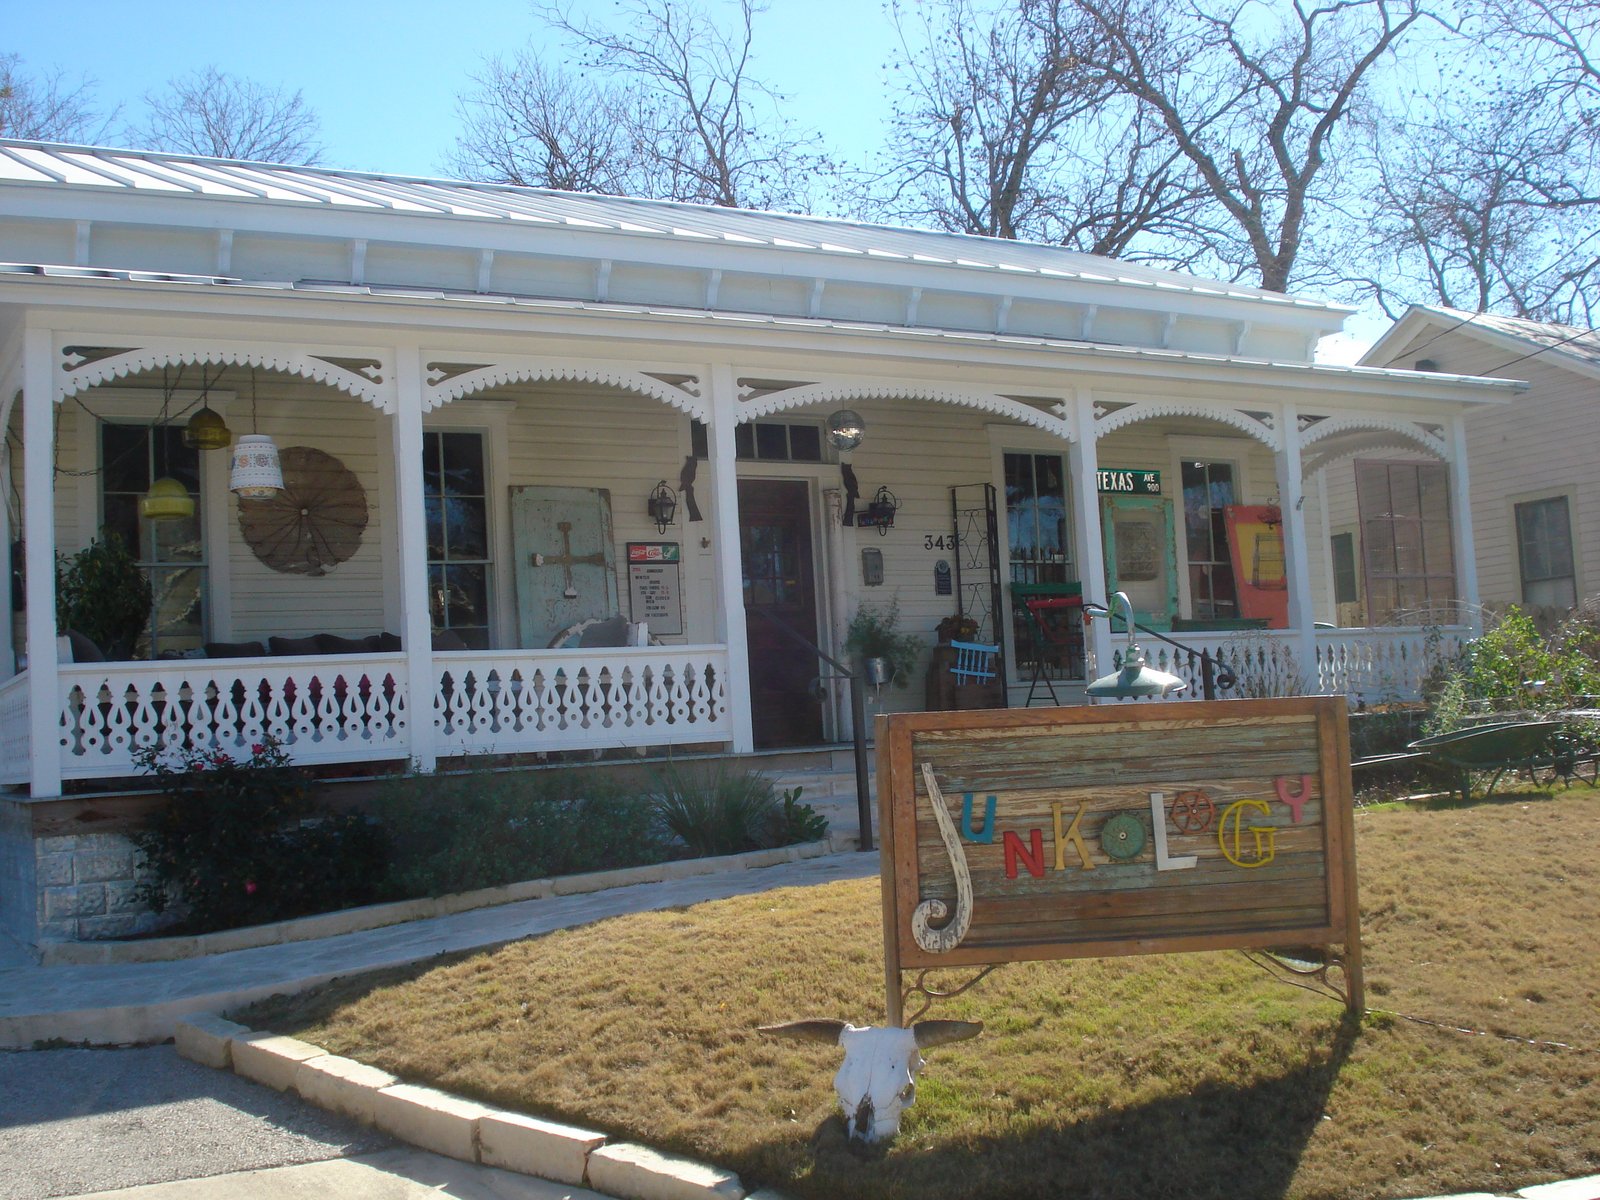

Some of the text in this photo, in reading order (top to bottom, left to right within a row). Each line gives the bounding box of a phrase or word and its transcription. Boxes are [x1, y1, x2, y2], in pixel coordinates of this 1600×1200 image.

[1096, 471, 1155, 491] TEXAS AVE
[1147, 483, 1160, 492] 900
[924, 534, 955, 551] 343
[911, 762, 1312, 954] JUNKOLOGY
